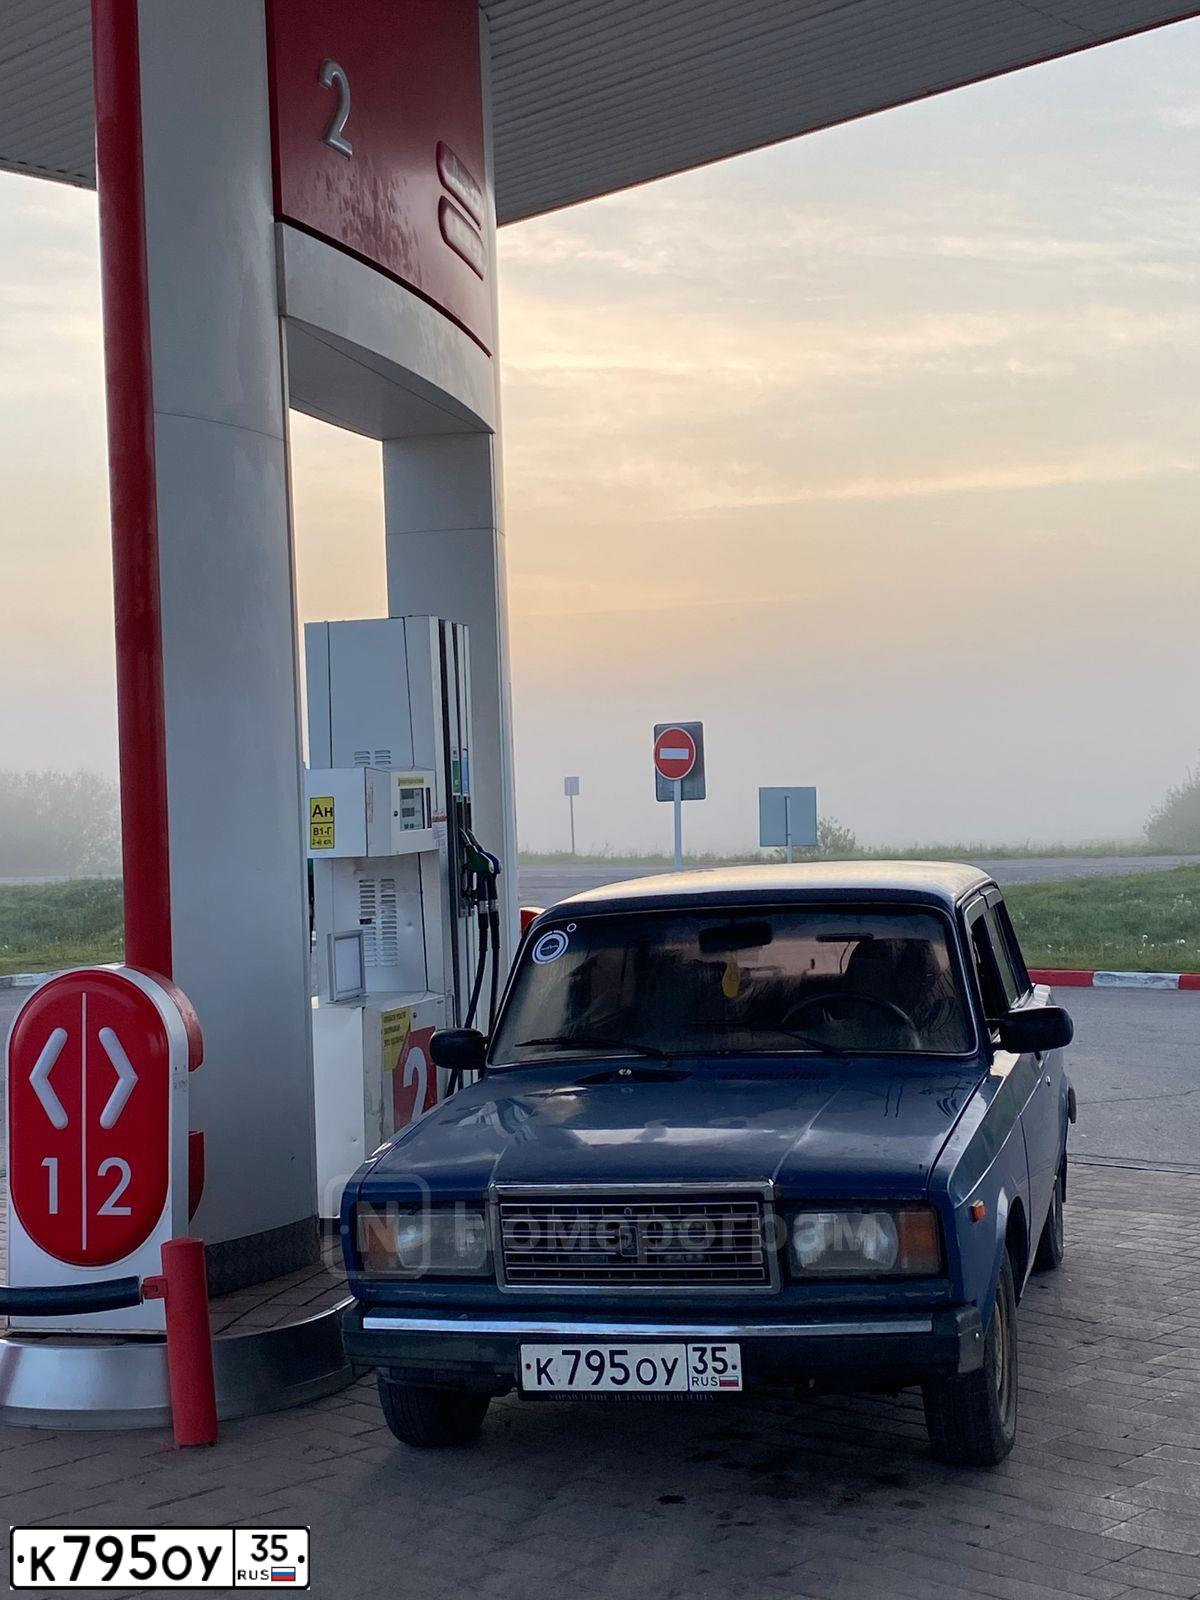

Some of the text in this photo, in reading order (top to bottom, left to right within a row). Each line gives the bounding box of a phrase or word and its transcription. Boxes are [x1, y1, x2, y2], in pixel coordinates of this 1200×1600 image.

[319, 57, 353, 161] 2
[312, 804, 333, 818] Ан
[41, 1157, 132, 1216] 1 2
[535, 1346, 729, 1386] К795ОУ 35
[691, 1376, 718, 1387] RUS
